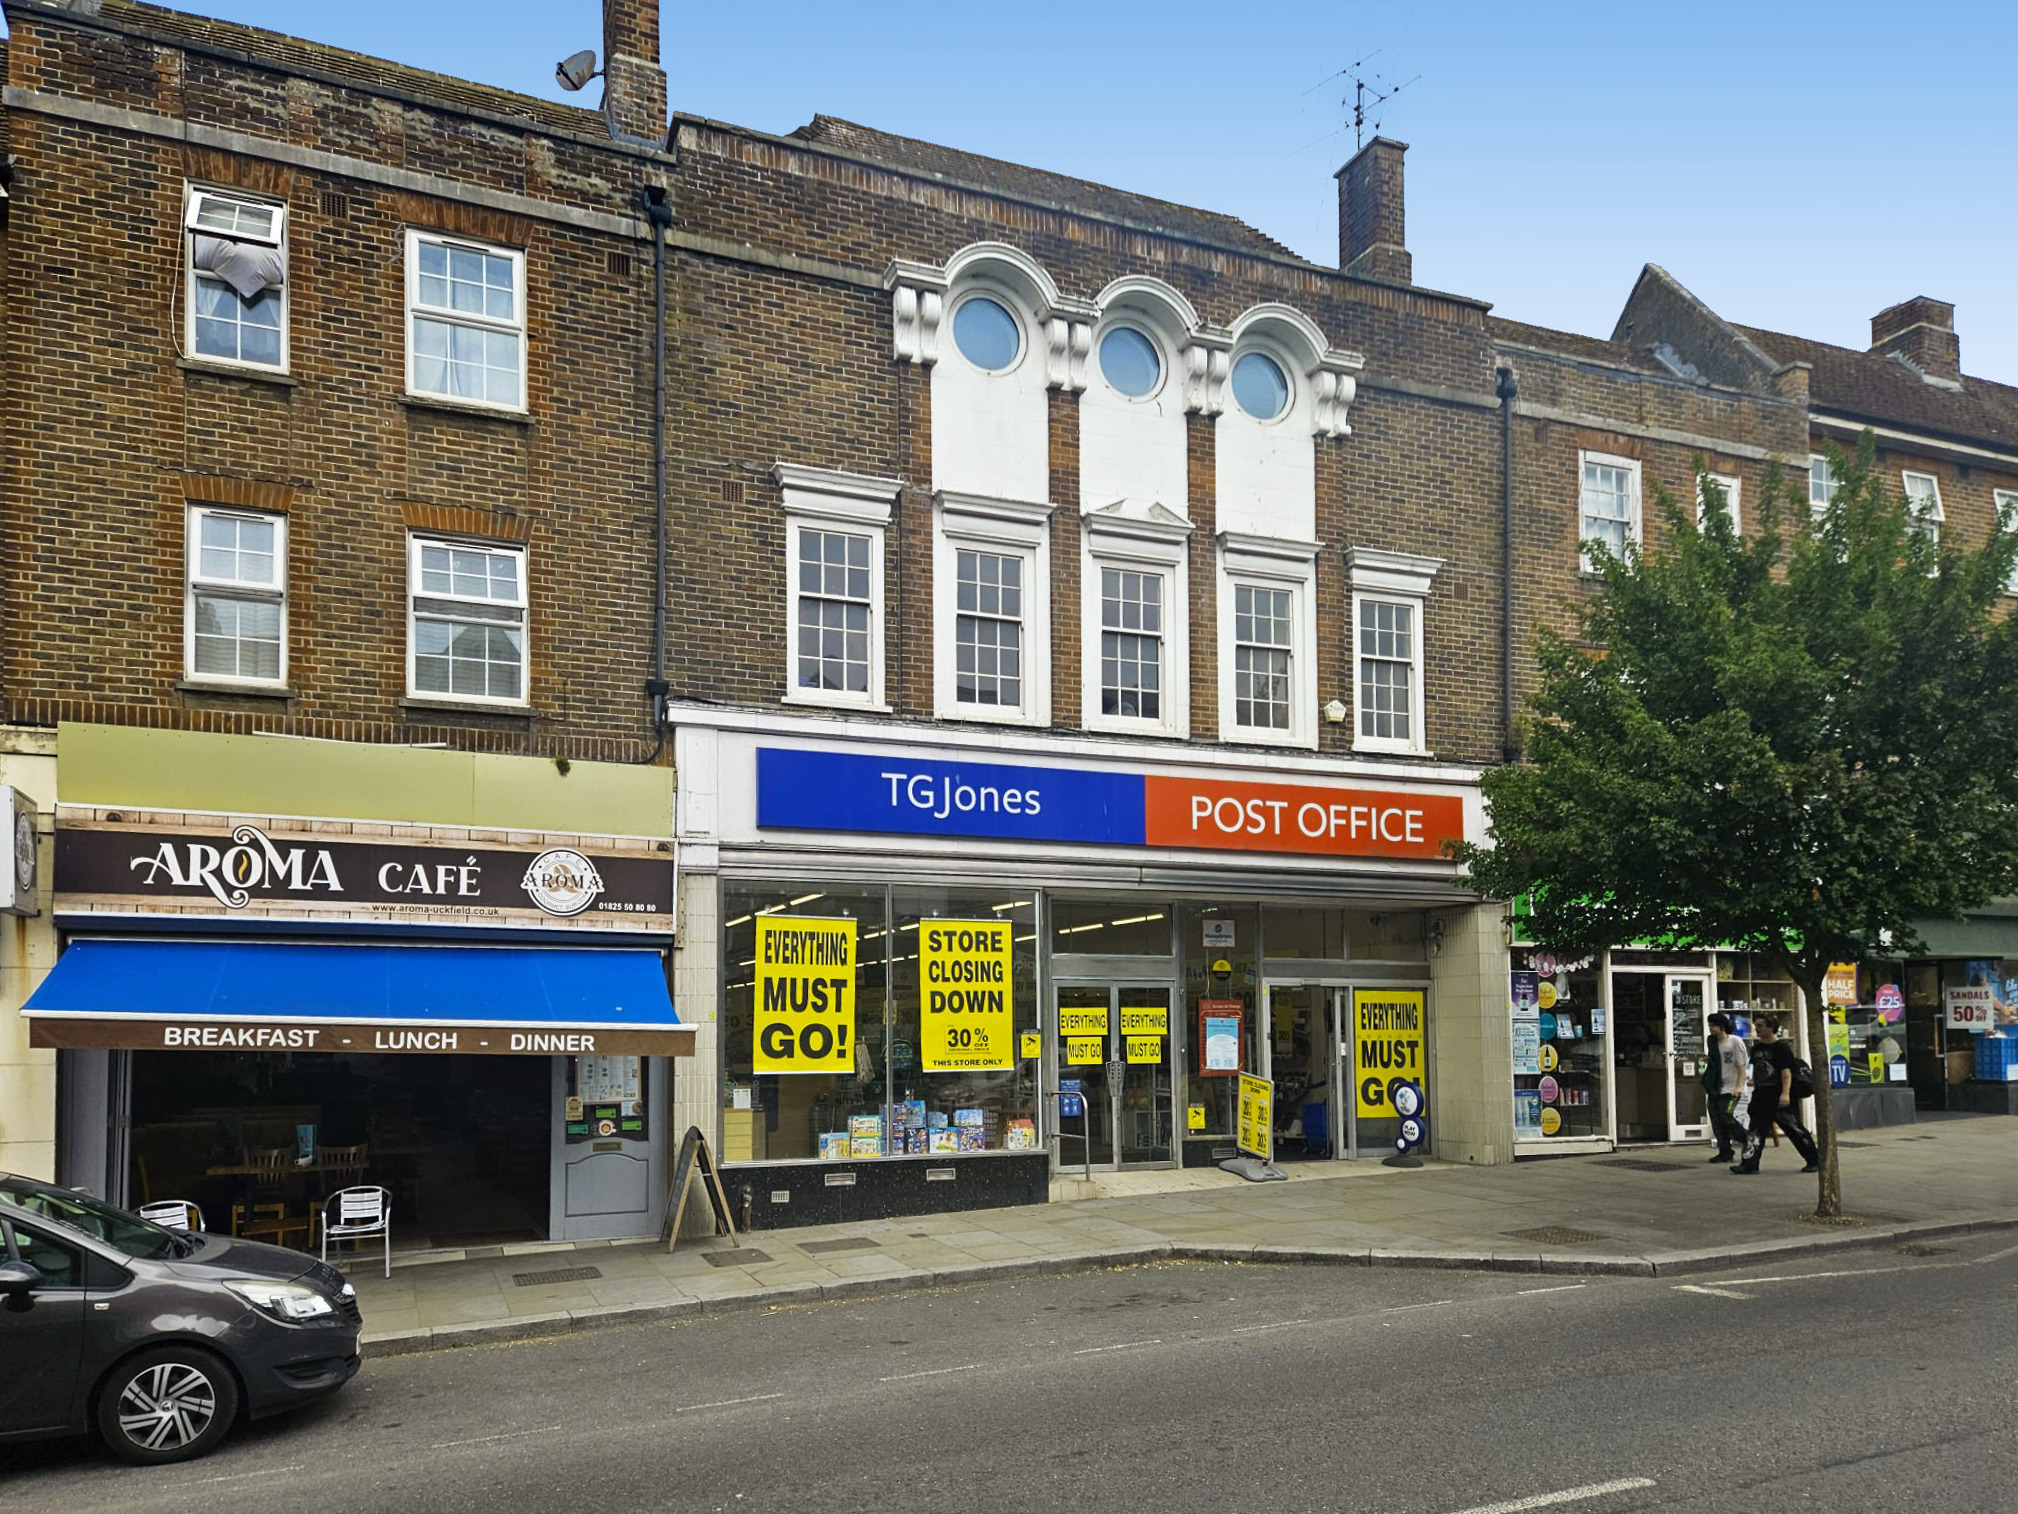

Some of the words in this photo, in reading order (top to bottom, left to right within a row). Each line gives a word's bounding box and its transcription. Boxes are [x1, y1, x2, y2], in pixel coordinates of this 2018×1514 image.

[881, 772, 1041, 820] TGJones
[1191, 795, 1289, 837] POST
[1297, 801, 1426, 843] OFFICE
[130, 825, 344, 909] AROMA
[377, 855, 482, 896] CAFÉ
[524, 872, 601, 890] AROMA
[372, 903, 499, 916] www.aroma-uckfield.co.uk
[598, 902, 622, 911] 01825
[624, 903, 634, 911] 50
[635, 903, 645, 911] 80
[646, 904, 657, 912] 80
[764, 930, 848, 966] EVERYTHING
[928, 930, 1004, 952] STORE
[928, 960, 1004, 983] CLOSING
[1827, 980, 1854, 989] HALF
[763, 977, 848, 1013] MUST
[930, 990, 1004, 1014] DOWN
[1827, 989, 1854, 999] PRICE
[1879, 997, 1900, 1008] £25
[1950, 991, 1990, 1000] SANDALS
[1061, 1014, 1107, 1029] EVERYTHING
[1122, 1014, 1166, 1028] EVERYTHING
[1361, 1002, 1418, 1031] EVERYTHING
[163, 1027, 319, 1048] BREAKFAST
[375, 1031, 458, 1050] LUNCH
[510, 1034, 595, 1052] DINNER
[760, 1022, 848, 1059] GO!
[1068, 1043, 1088, 1058] MUST
[1090, 1043, 1101, 1058] GO
[1128, 1043, 1148, 1057] MUST
[1150, 1043, 1160, 1057] GO
[1361, 1039, 1419, 1069] MUST
[983, 1058, 1003, 1066] ONLY
[1831, 1065, 1846, 1082] TV
